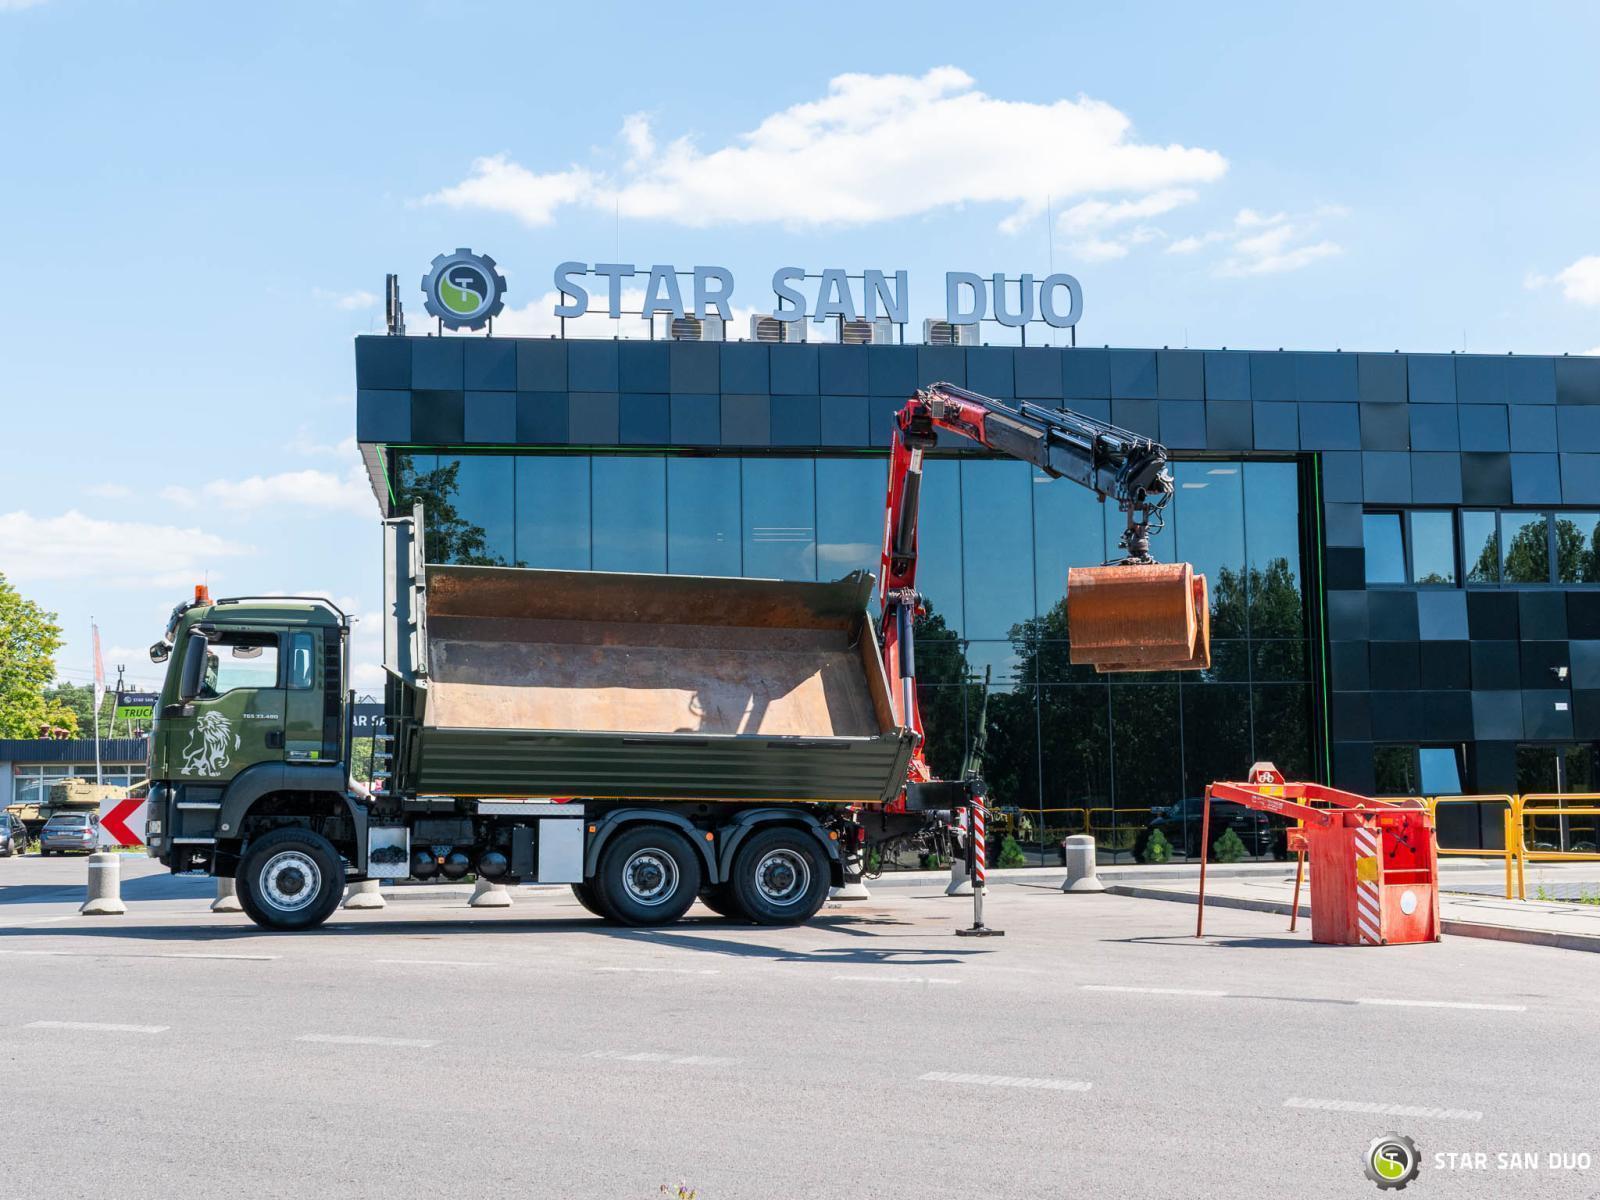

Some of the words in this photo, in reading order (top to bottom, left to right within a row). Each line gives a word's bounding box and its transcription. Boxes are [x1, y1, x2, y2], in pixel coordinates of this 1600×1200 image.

[554, 261, 735, 321] STAR
[772, 267, 908, 324] SAN
[946, 271, 1083, 328] DUO
